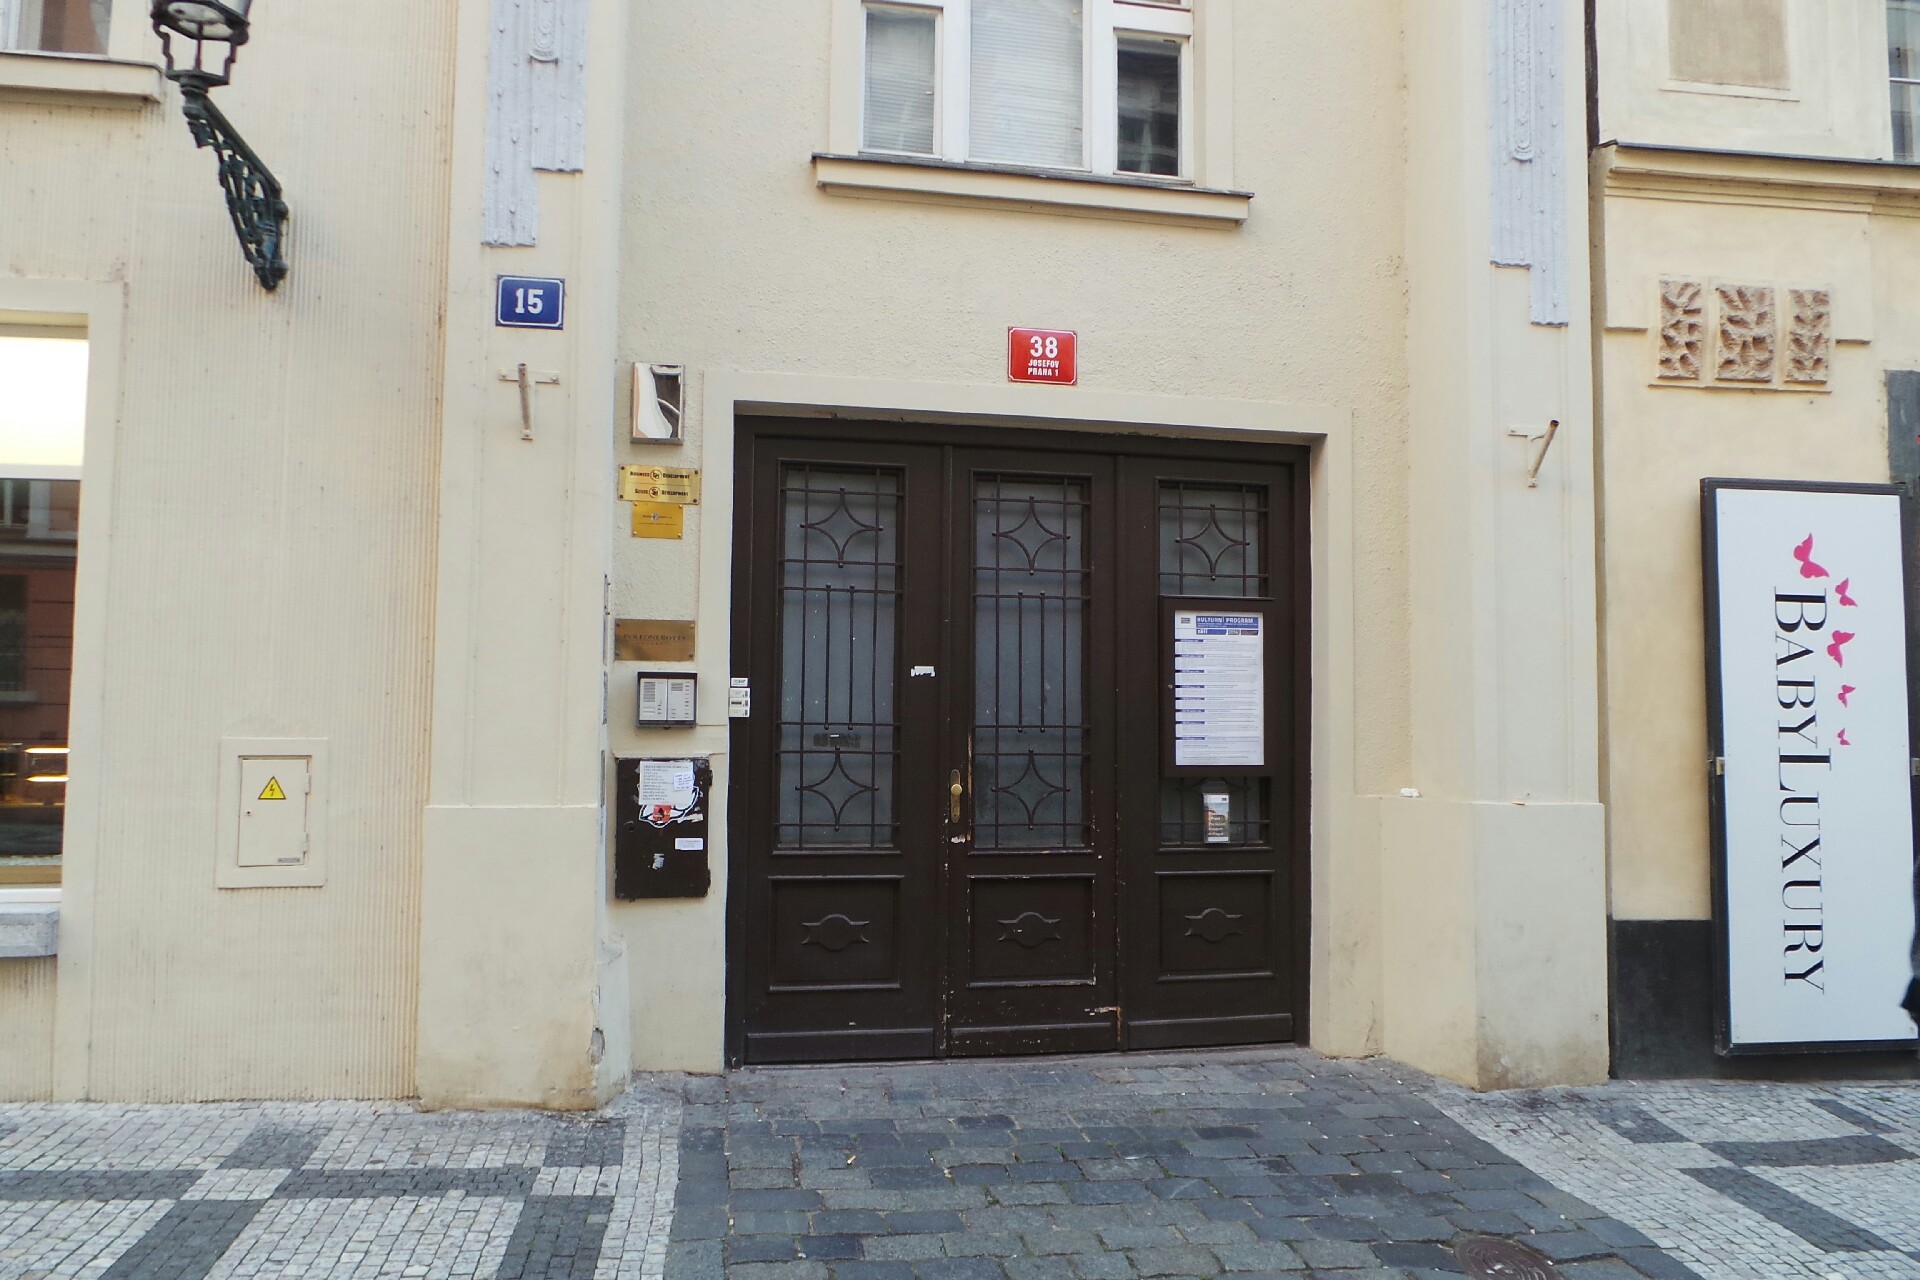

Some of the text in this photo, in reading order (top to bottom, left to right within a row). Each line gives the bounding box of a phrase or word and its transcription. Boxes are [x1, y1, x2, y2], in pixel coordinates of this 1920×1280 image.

[515, 288, 543, 314] 15
[1030, 335, 1058, 358] 38
[1028, 359, 1059, 368] JOSEFOV
[1028, 367, 1059, 377] PRAHA 1
